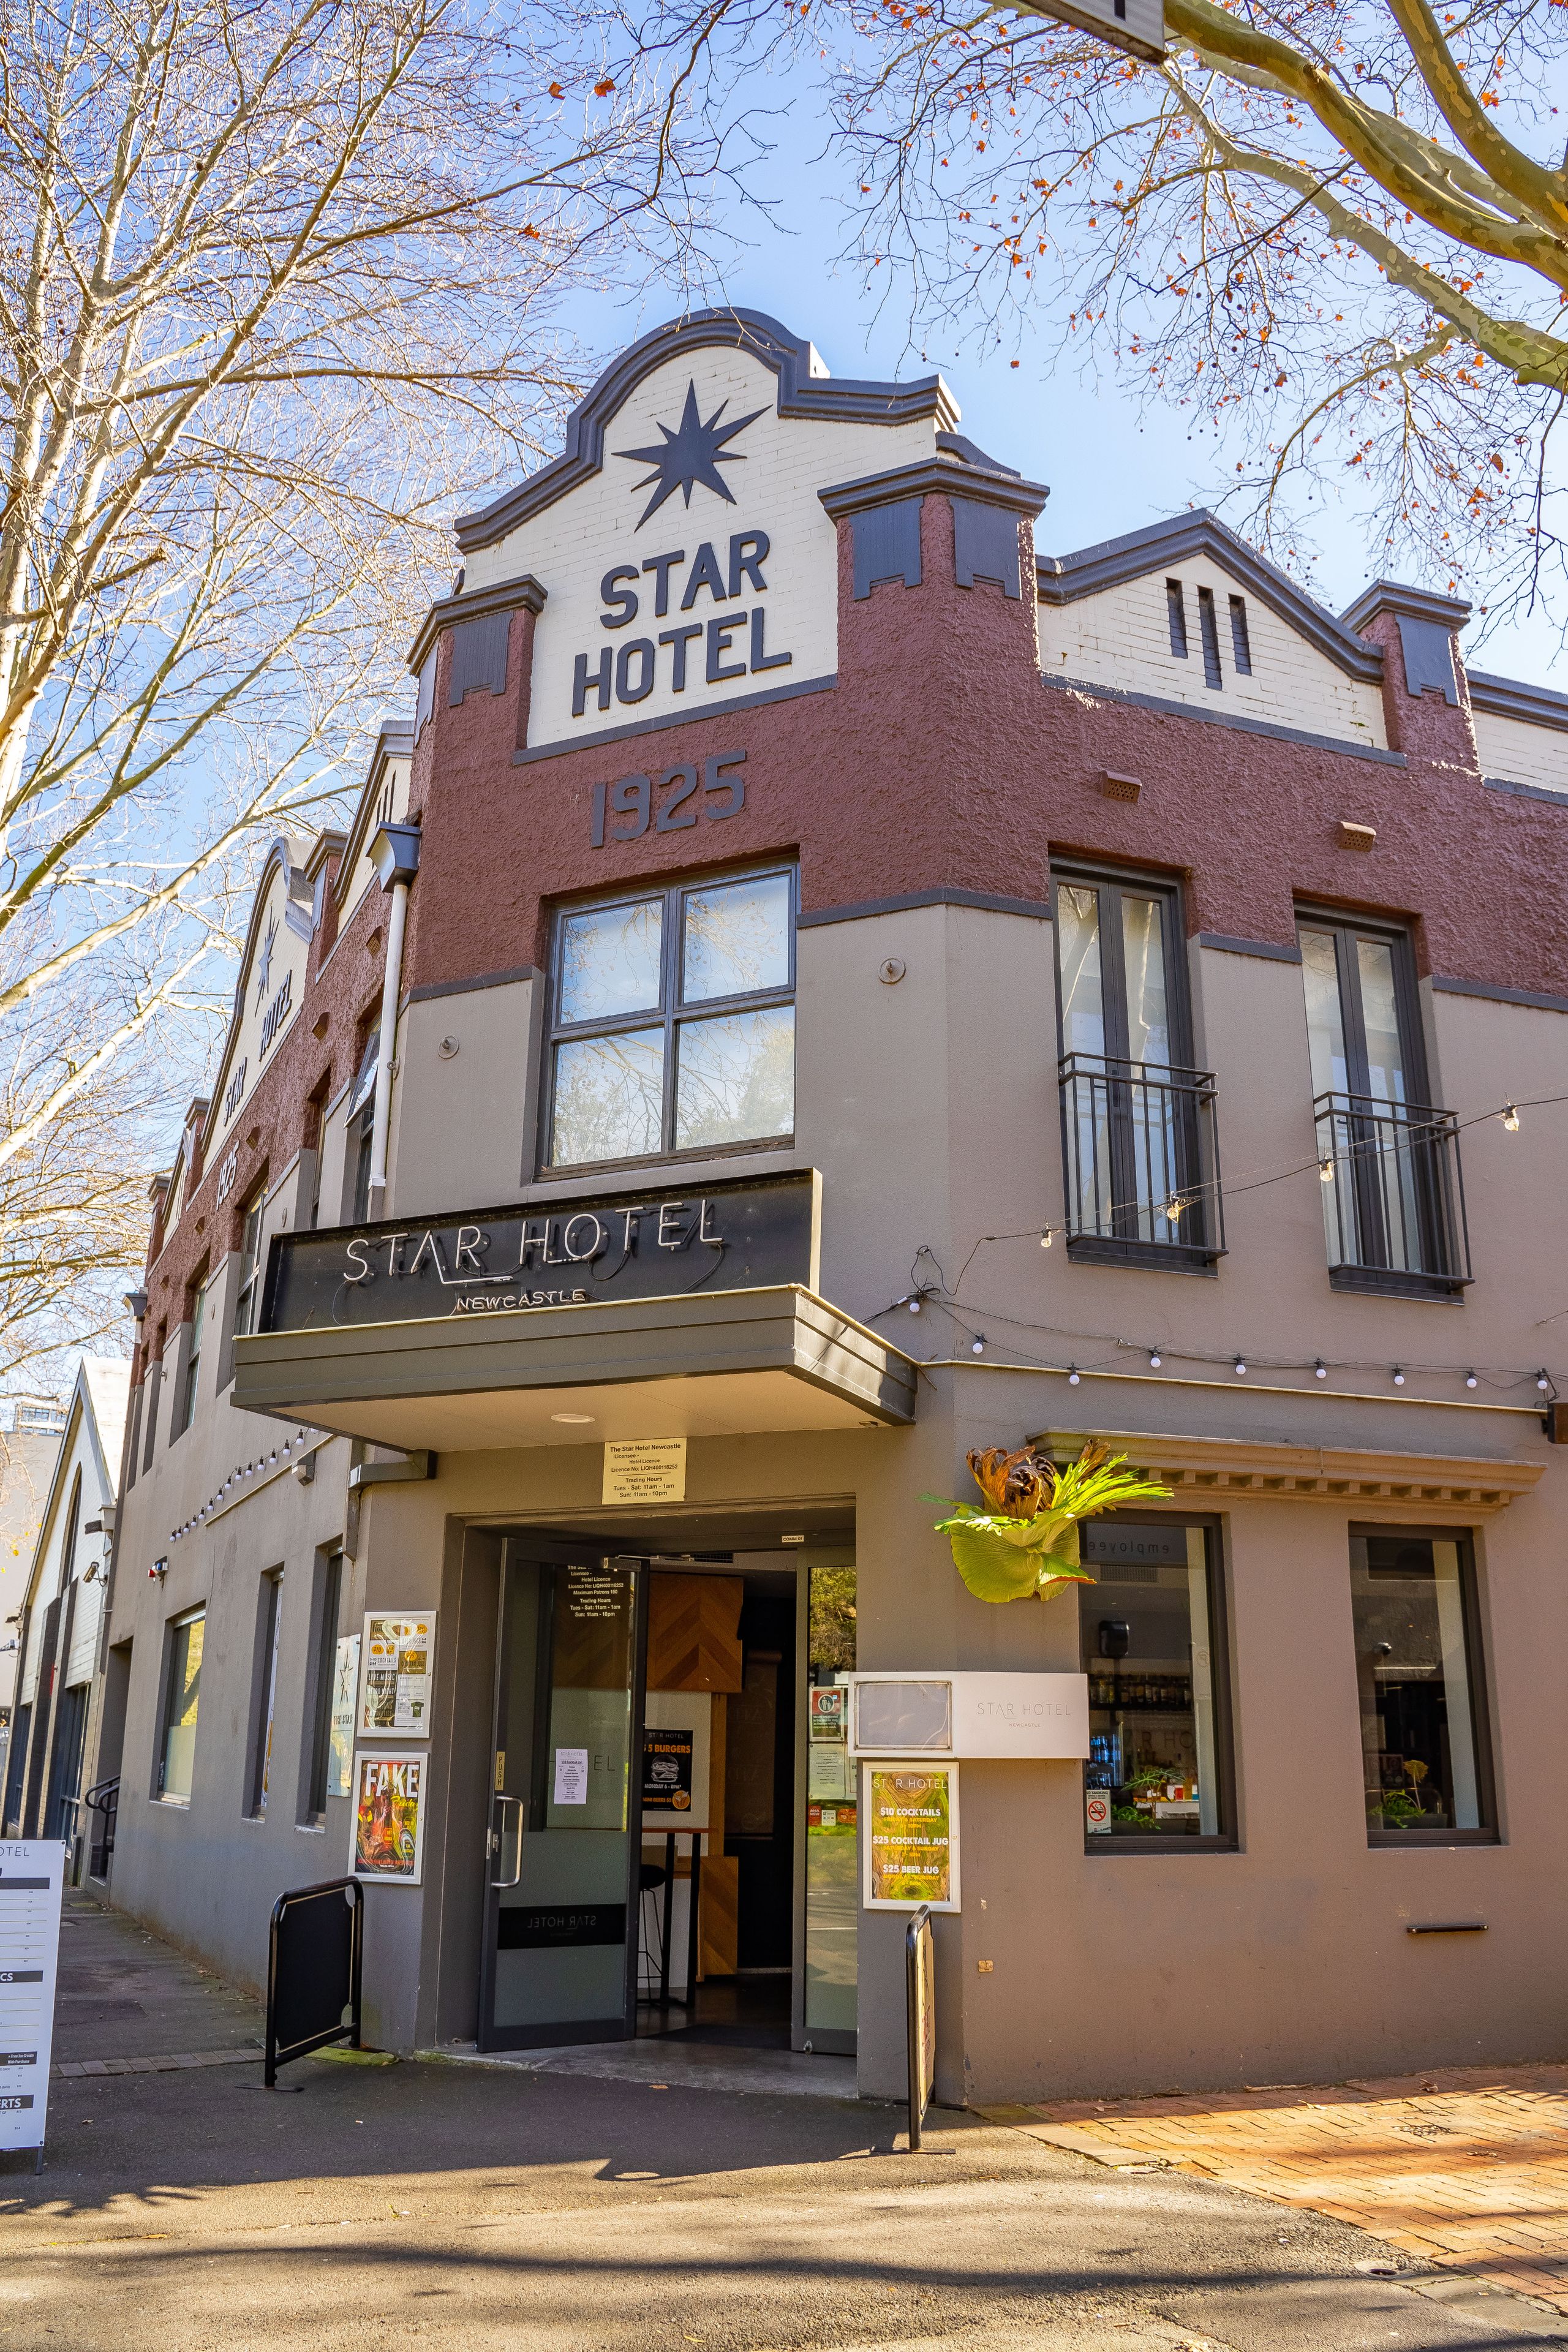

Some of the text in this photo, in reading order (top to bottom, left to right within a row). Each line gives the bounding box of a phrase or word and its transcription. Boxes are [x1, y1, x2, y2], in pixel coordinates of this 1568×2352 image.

[600, 529, 771, 628] STAR
[571, 607, 792, 717] HOTEL
[591, 749, 746, 848] 1925
[259, 970, 292, 1062] HOTEL
[216, 1139, 239, 1211] 1925
[343, 1198, 725, 1285] STAR HOTEL
[456, 1289, 587, 1311] NEWCASTLE
[342, 1714, 353, 1725] STAR
[977, 1703, 1071, 1719] STAR HOTEL
[654, 1744, 691, 1754] BURGERS
[366, 1763, 419, 1797] FAKE
[873, 1779, 948, 1789] STR HOTEL
[880, 1806, 941, 1817] $10 COCKTAILS
[873, 1834, 949, 1845] $25 COCKTAIL JUG
[883, 1864, 940, 1874] $25 BEER JUG
[0, 2098, 21, 2108] RTS
